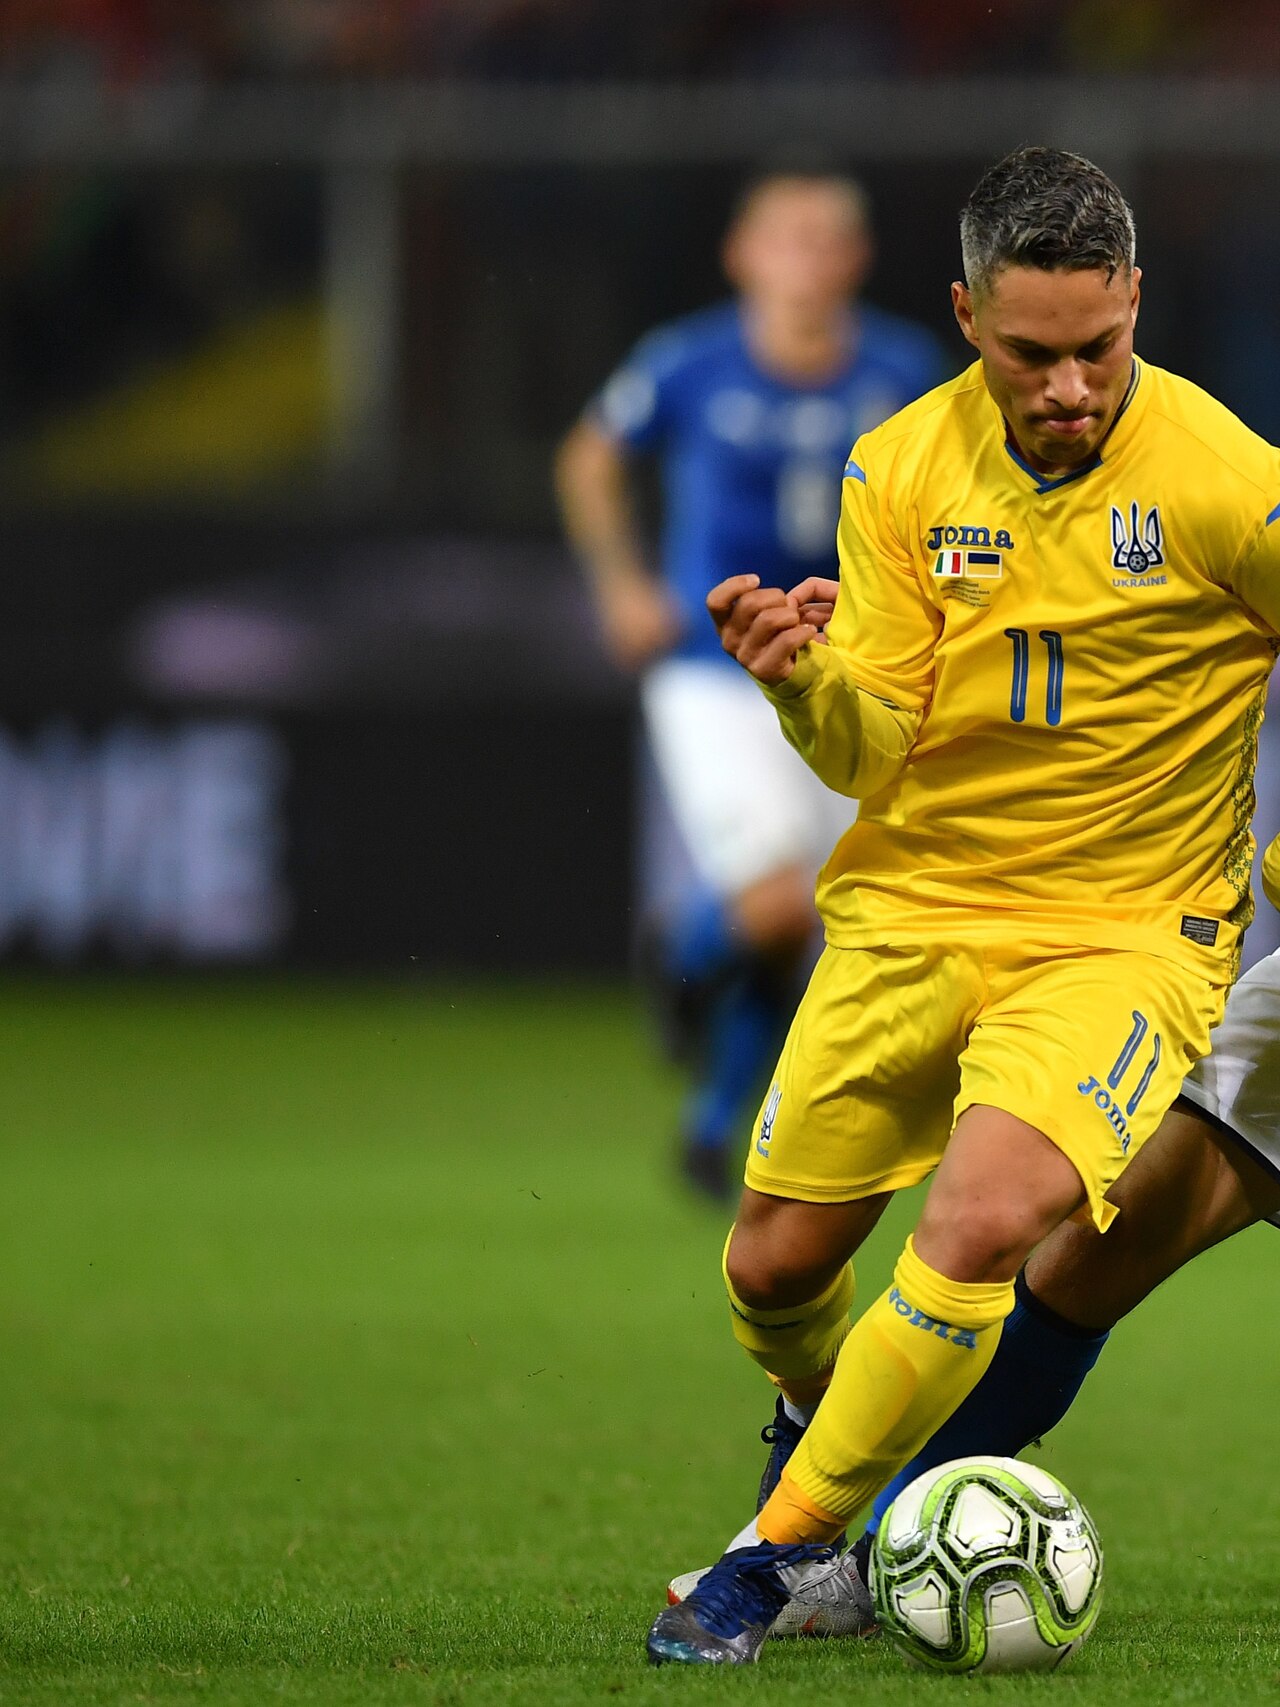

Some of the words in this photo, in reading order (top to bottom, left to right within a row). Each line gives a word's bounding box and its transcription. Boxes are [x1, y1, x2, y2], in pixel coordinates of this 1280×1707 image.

[1112, 574, 1168, 587] UKRAINE
[1004, 628, 1064, 727] 11
[1107, 1010, 1161, 1117] 11
